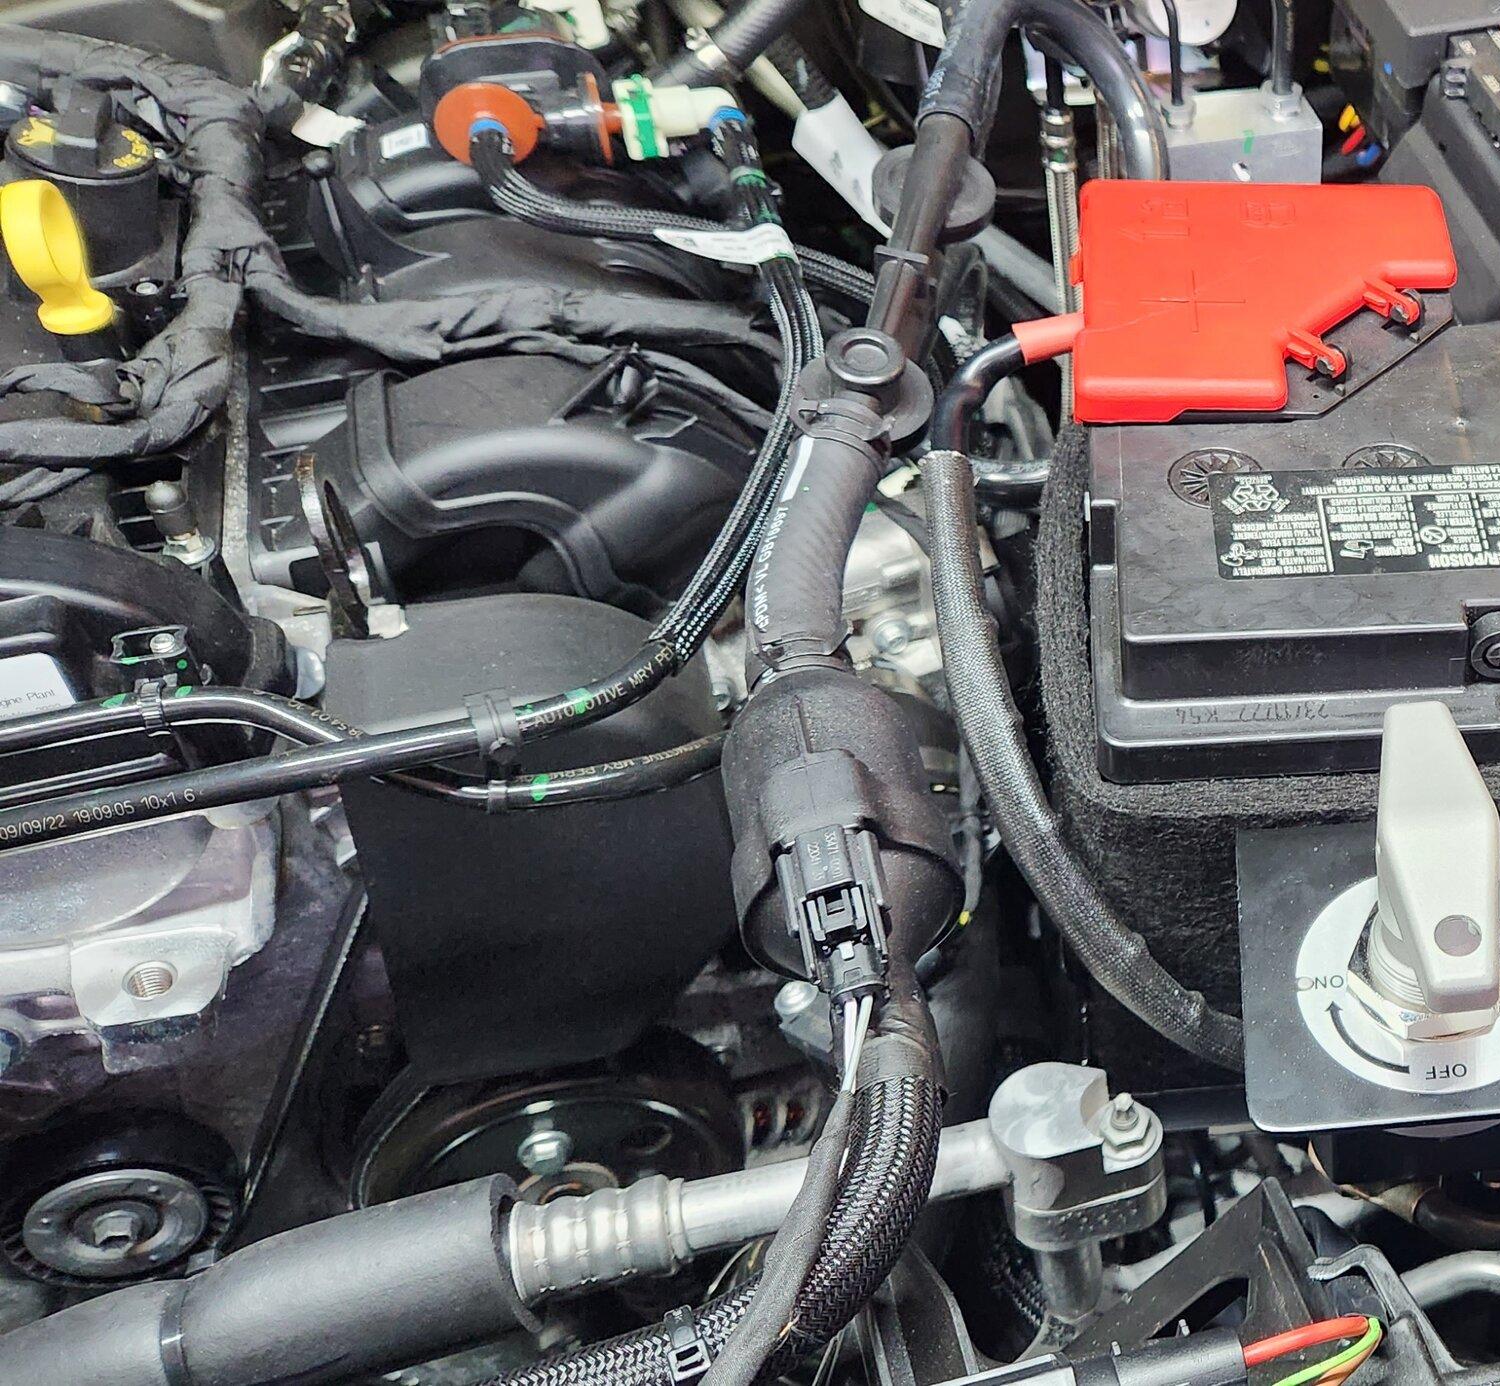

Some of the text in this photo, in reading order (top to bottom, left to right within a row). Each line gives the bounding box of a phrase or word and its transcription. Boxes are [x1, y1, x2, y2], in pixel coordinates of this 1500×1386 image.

[1490, 465, 1500, 473] LA
[1381, 476, 1397, 484] PAS
[1398, 476, 1409, 484] NE
[1447, 474, 1462, 482] DES
[1469, 481, 1478, 489] OF
[1337, 486, 1358, 494] OPEN
[1392, 496, 1406, 504] DES
[1391, 504, 1407, 512] PEUT
[1267, 522, 1278, 530] UN
[1279, 521, 1319, 529] CONSULTEZ
[1369, 522, 1398, 530] SEVERE
[1436, 518, 1448, 526] LES
[1330, 530, 1412, 540] CAN CAUSE BLINDNESS
[1282, 538, 1296, 546] LES
[1392, 538, 1414, 546] ACID
[1278, 548, 1294, 557] HELP
[1295, 547, 1325, 556] MEDICAL
[1261, 558, 1276, 566] GET
[1306, 556, 1326, 564] WITH
[1233, 565, 1327, 576] FLUSH EYES IMMEDIATELY
[629, 662, 654, 690] MRY
[0, 815, 67, 840] 09/09/22
[1314, 974, 1343, 989] ON
[1425, 1063, 1466, 1080] OFF
